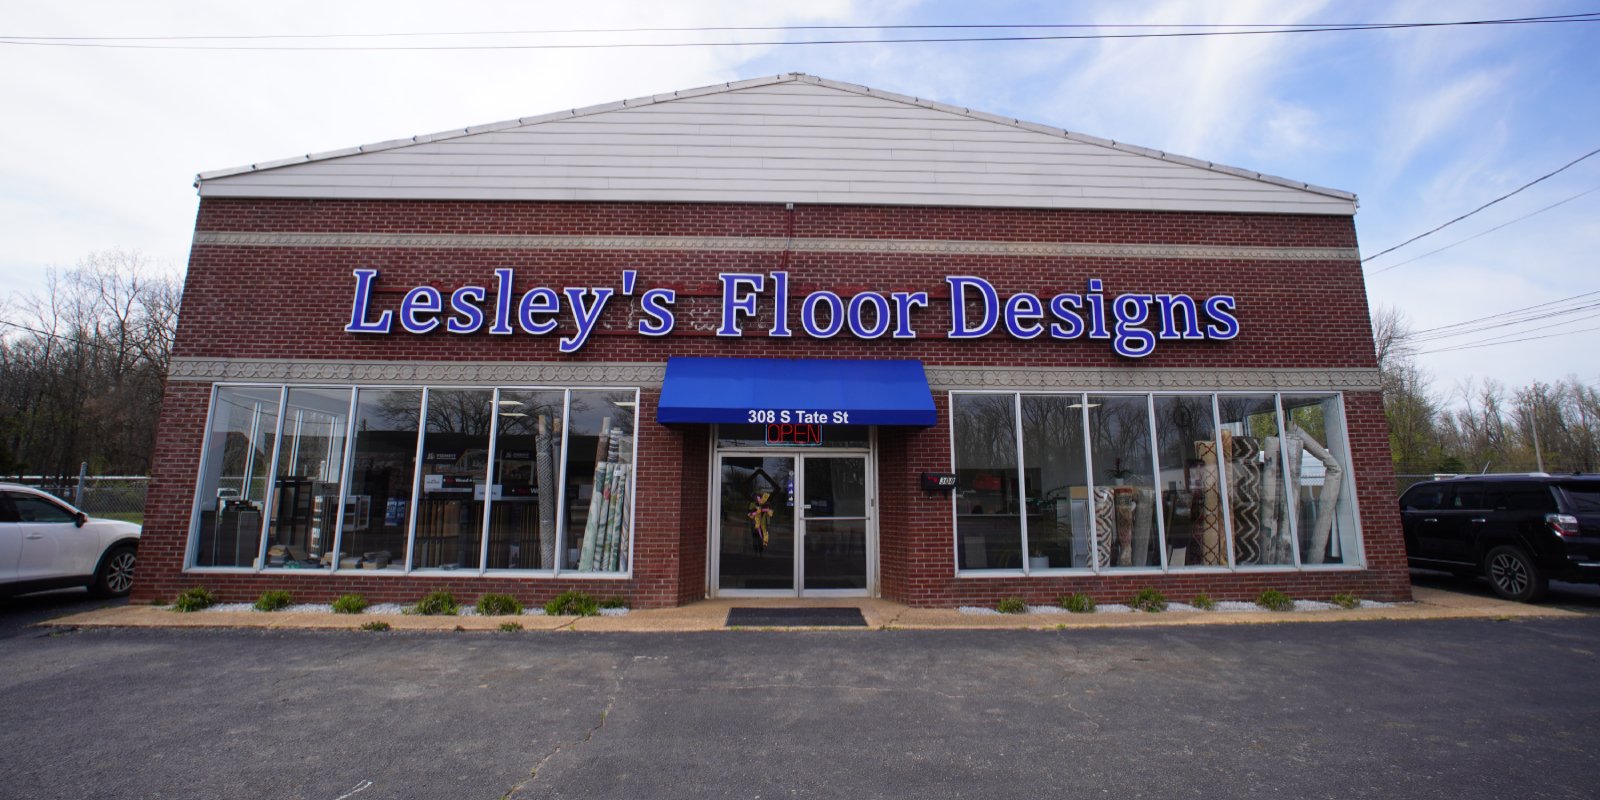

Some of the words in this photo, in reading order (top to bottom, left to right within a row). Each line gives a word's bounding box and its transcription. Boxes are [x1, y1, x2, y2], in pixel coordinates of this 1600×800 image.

[344, 268, 676, 353] Lesley's
[716, 270, 929, 339] Floor
[945, 274, 1240, 358] Designs
[748, 409, 776, 424] 308
[780, 410, 791, 424] S
[795, 410, 828, 424] Tate
[832, 410, 849, 424] St
[767, 423, 820, 444] OPEN
[939, 476, 956, 486] 308
